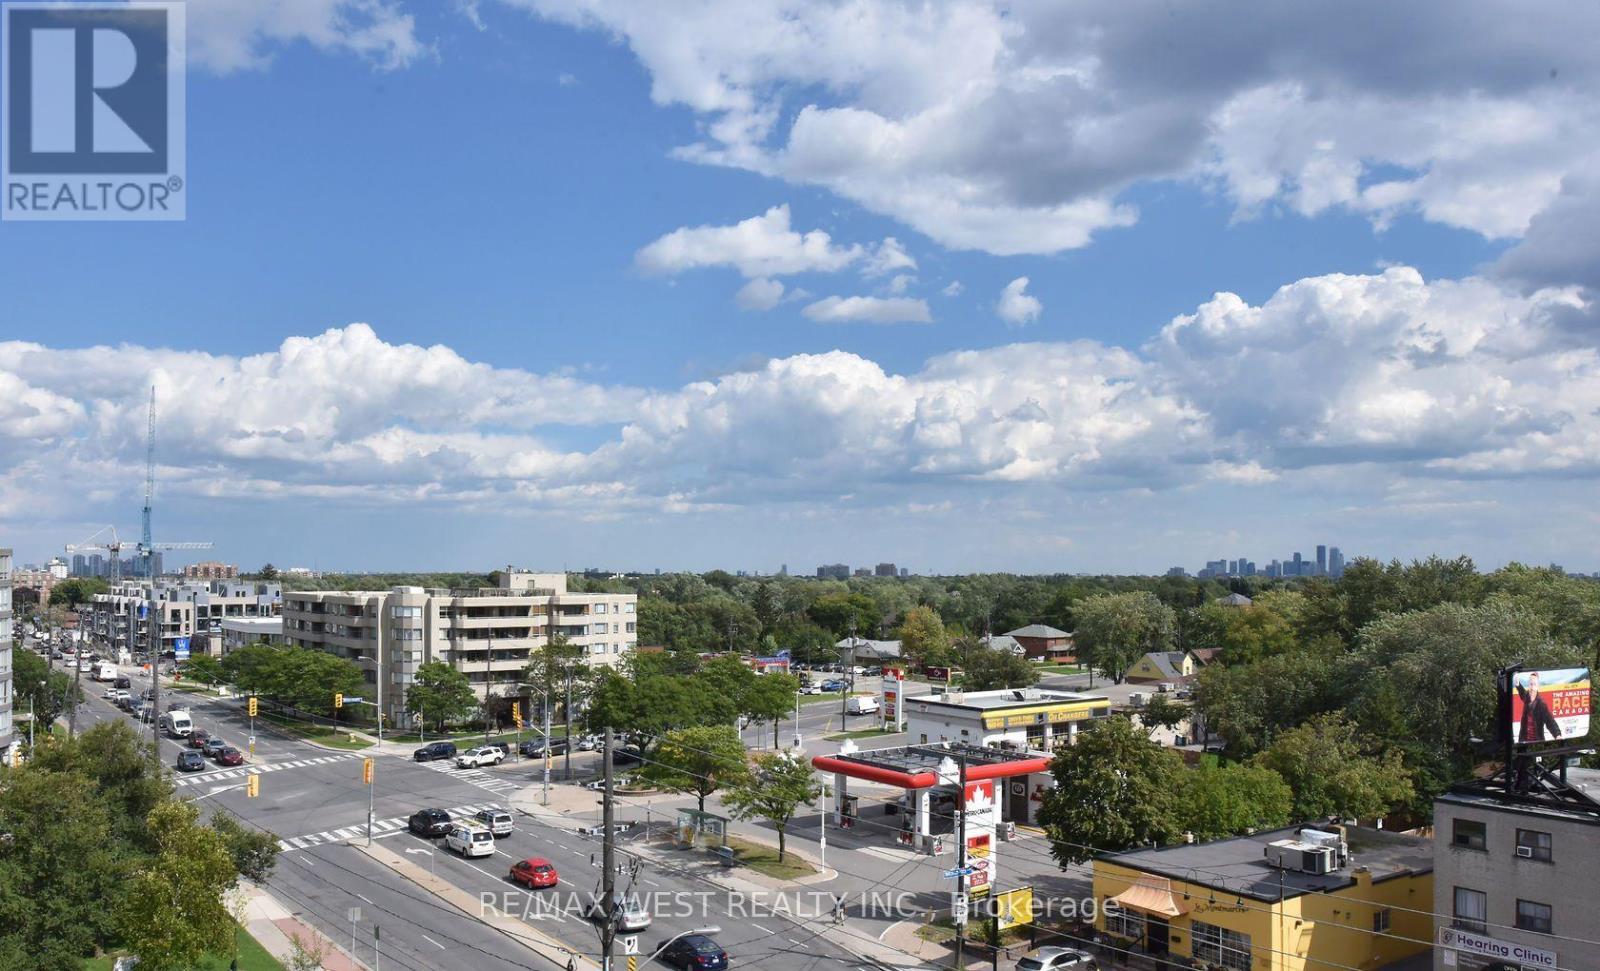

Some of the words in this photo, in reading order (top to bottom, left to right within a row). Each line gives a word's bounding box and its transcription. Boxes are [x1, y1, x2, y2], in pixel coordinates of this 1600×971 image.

[1552, 695, 1590, 710] RACE
[1552, 707, 1590, 716] CANADA
[1457, 934, 1509, 957] Hearing
[1513, 947, 1552, 965] Clinic
